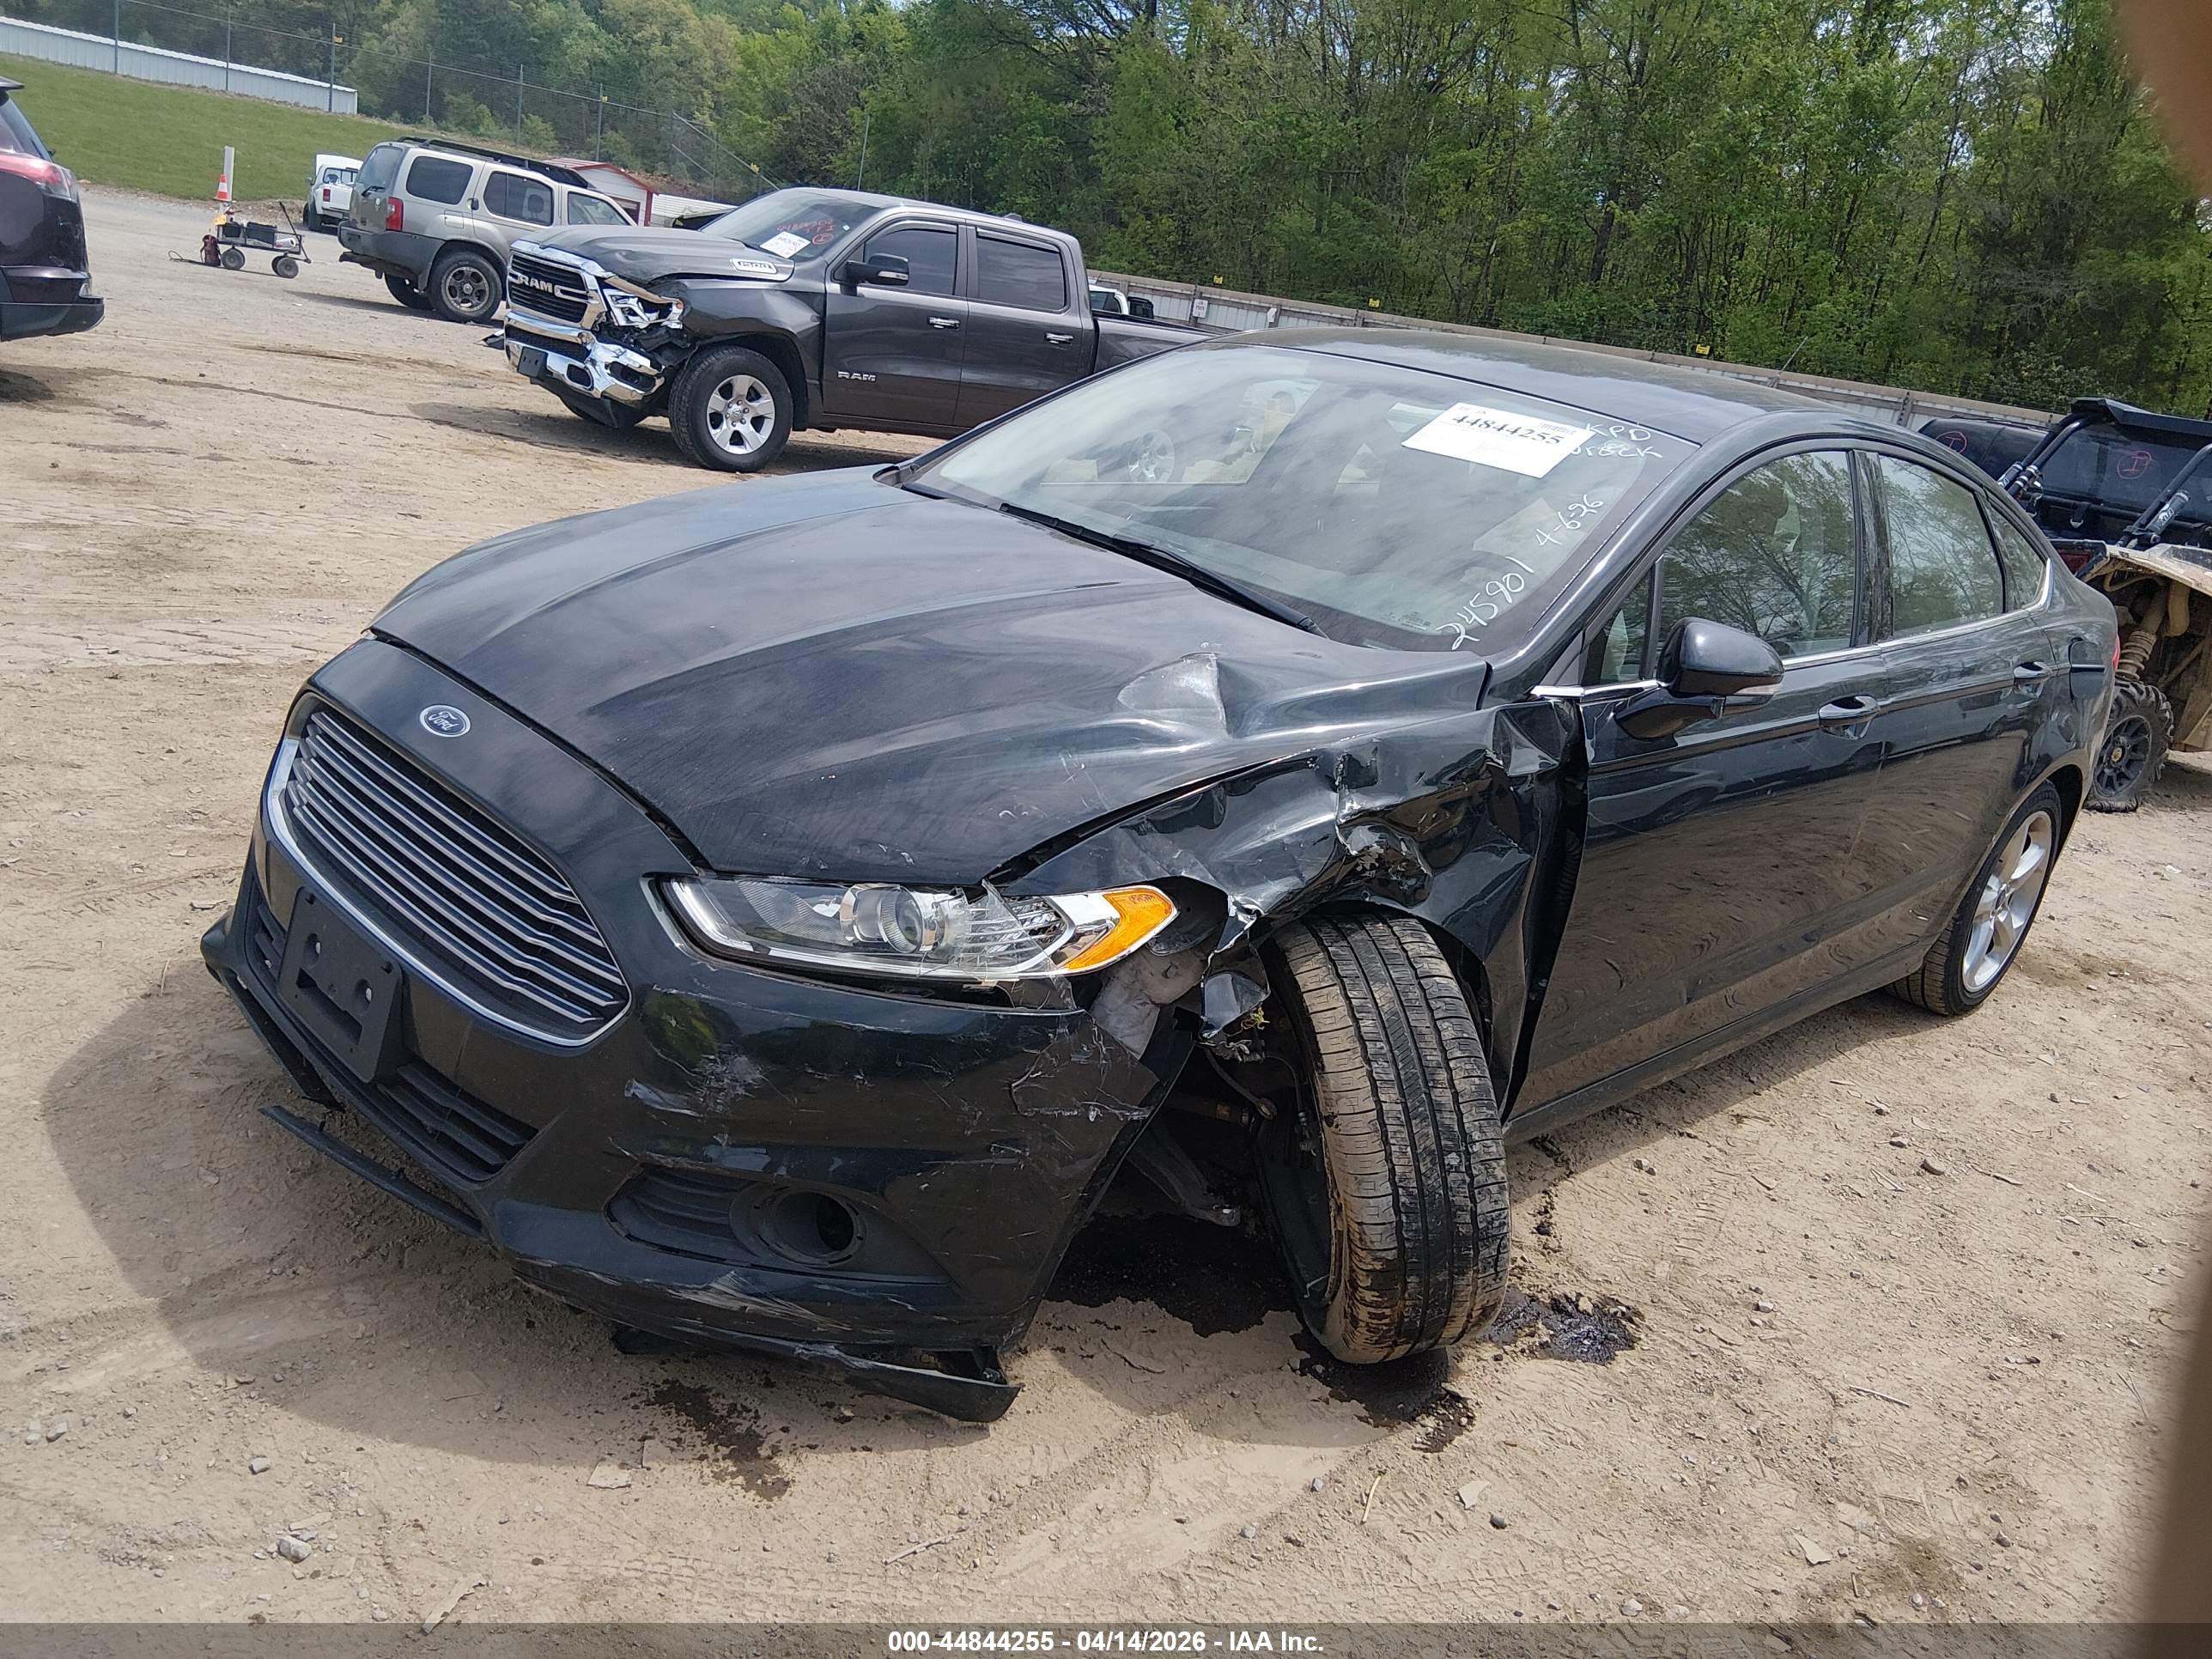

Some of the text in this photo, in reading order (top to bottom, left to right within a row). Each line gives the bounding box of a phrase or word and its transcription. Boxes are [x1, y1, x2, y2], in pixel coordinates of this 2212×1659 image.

[518, 274, 553, 294] RAM
[837, 371, 876, 381] RAM
[1452, 416, 1565, 444] 44844255
[1584, 422, 1651, 441] KPD
[1436, 556, 1534, 651] 245901
[428, 710, 459, 731] Ford
